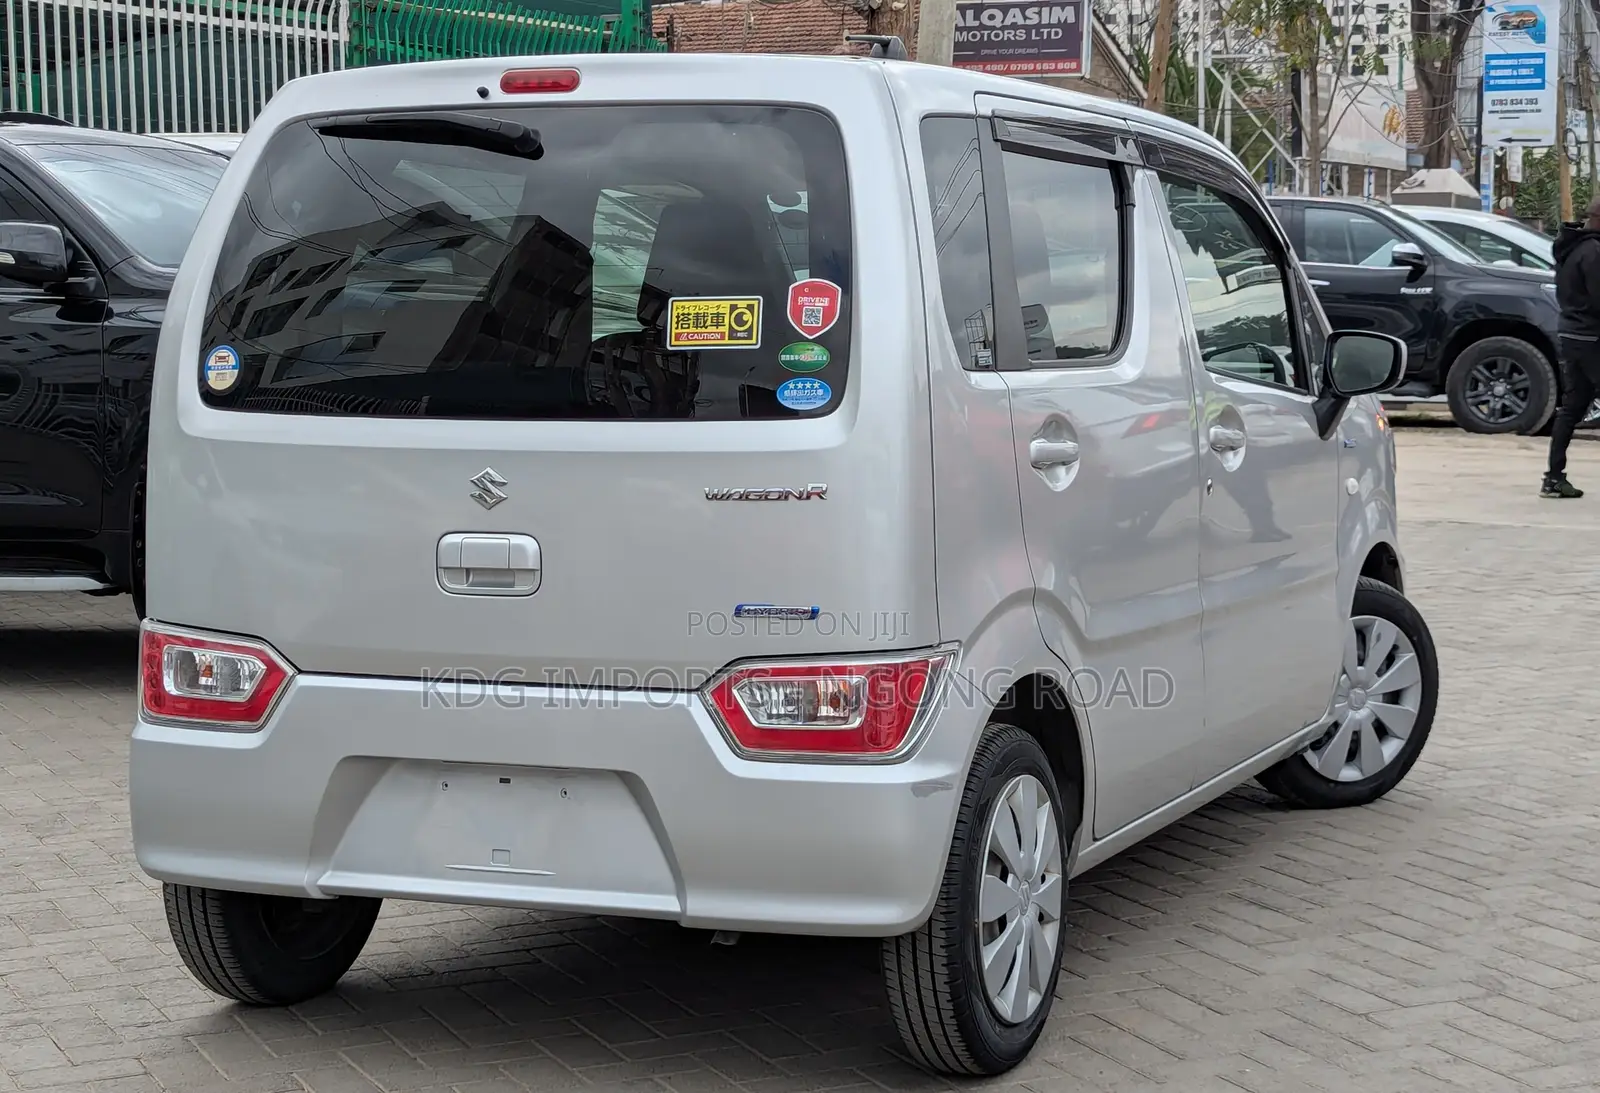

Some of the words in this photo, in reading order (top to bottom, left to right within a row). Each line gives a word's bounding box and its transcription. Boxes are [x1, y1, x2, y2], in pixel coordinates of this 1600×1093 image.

[955, 6, 1076, 27] ALQASIM
[955, 29, 1026, 42] MOTORS
[1031, 28, 1063, 40] LTD
[675, 312, 727, 330] 搭載車
